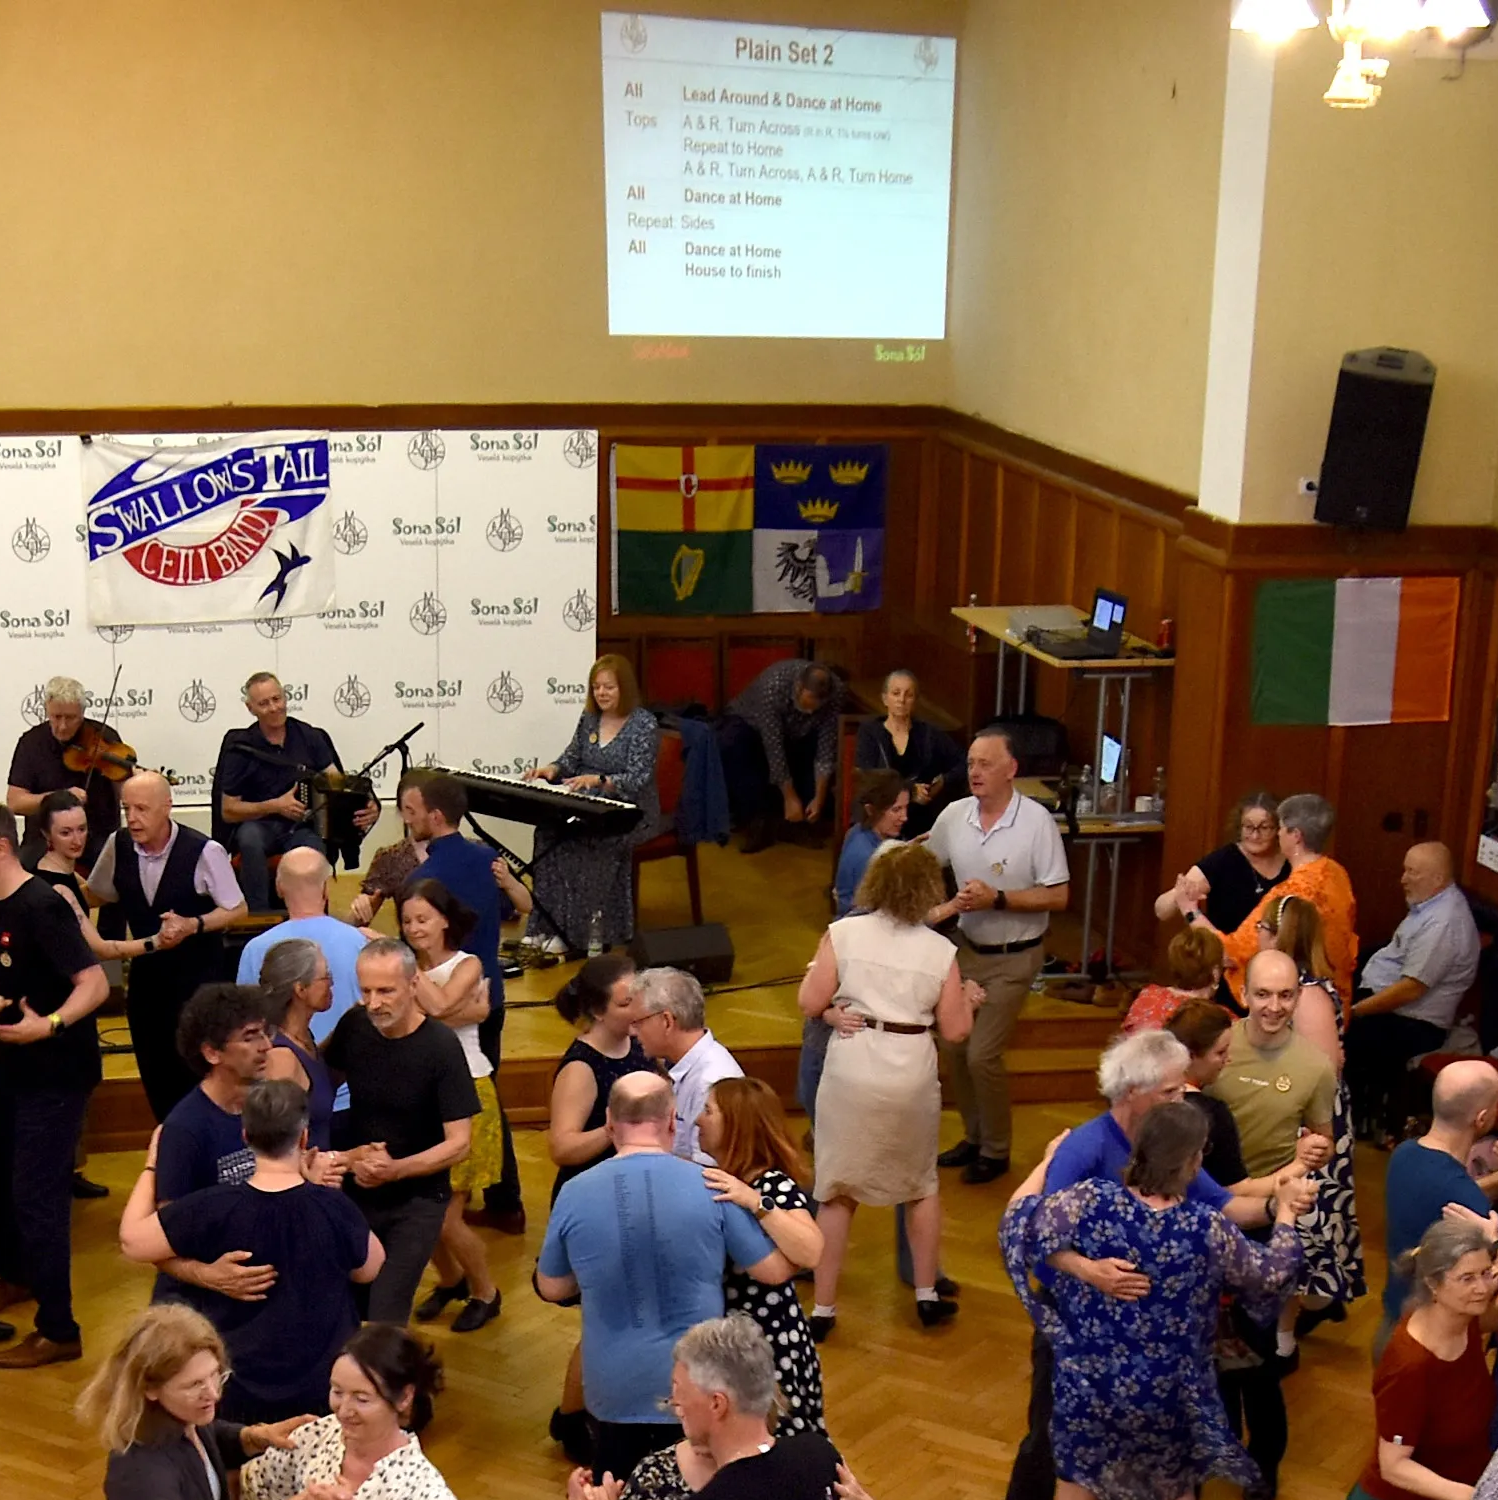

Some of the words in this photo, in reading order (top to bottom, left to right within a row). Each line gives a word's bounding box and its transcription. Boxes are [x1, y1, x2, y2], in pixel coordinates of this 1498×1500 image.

[736, 38, 781, 62] Plain
[789, 42, 817, 65] Set
[824, 44, 833, 65] 2
[625, 82, 643, 98] All
[683, 86, 715, 102] Lead
[719, 91, 768, 107] Around
[772, 93, 781, 106] &
[786, 94, 826, 110] Dance
[830, 98, 842, 111] at
[846, 98, 882, 112] Home
[626, 111, 657, 129] Tops
[683, 116, 693, 129] A
[697, 116, 705, 129] &
[728, 118, 754, 133] Turn
[759, 120, 800, 136] Across
[684, 138, 729, 157] Repeat
[733, 142, 743, 155] to
[748, 143, 783, 157] Home
[684, 162, 693, 175] A
[697, 162, 705, 176] &
[729, 164, 755, 179] Turn
[807, 168, 815, 181] A
[820, 168, 828, 182] &
[850, 170, 876, 184] Turn
[879, 172, 912, 186] Home
[627, 185, 644, 201] All
[684, 189, 725, 205] Dance
[729, 191, 741, 205] at
[745, 191, 782, 206] Home
[681, 216, 715, 230] Sides
[629, 240, 646, 255] All
[685, 243, 725, 258] Dance
[729, 245, 741, 258] at
[746, 244, 781, 259] Home
[685, 265, 726, 278] House
[730, 266, 742, 278] to
[746, 265, 781, 279] finish
[36, 440, 61, 458] Sól
[357, 435, 381, 452] Sól
[470, 435, 509, 451] Sona
[513, 433, 537, 450] Sól
[88, 454, 255, 557] SWALLOW'S
[258, 447, 327, 491] TAIL
[392, 519, 431, 534] Sona
[436, 517, 461, 534] Sól
[547, 516, 586, 532] Sona
[141, 539, 209, 584] CEILI
[212, 511, 269, 574] BAND
[359, 601, 384, 618] Sól
[471, 599, 510, 615] Sona
[513, 598, 538, 614] Sól
[0, 611, 41, 628] Sona
[45, 609, 69, 626] Sól
[395, 682, 434, 698] Sona
[437, 680, 462, 697] Sól
[547, 679, 585, 694] Sona
[85, 692, 124, 708] Sona
[127, 690, 152, 706] Sól
[472, 758, 511, 775] Sona
